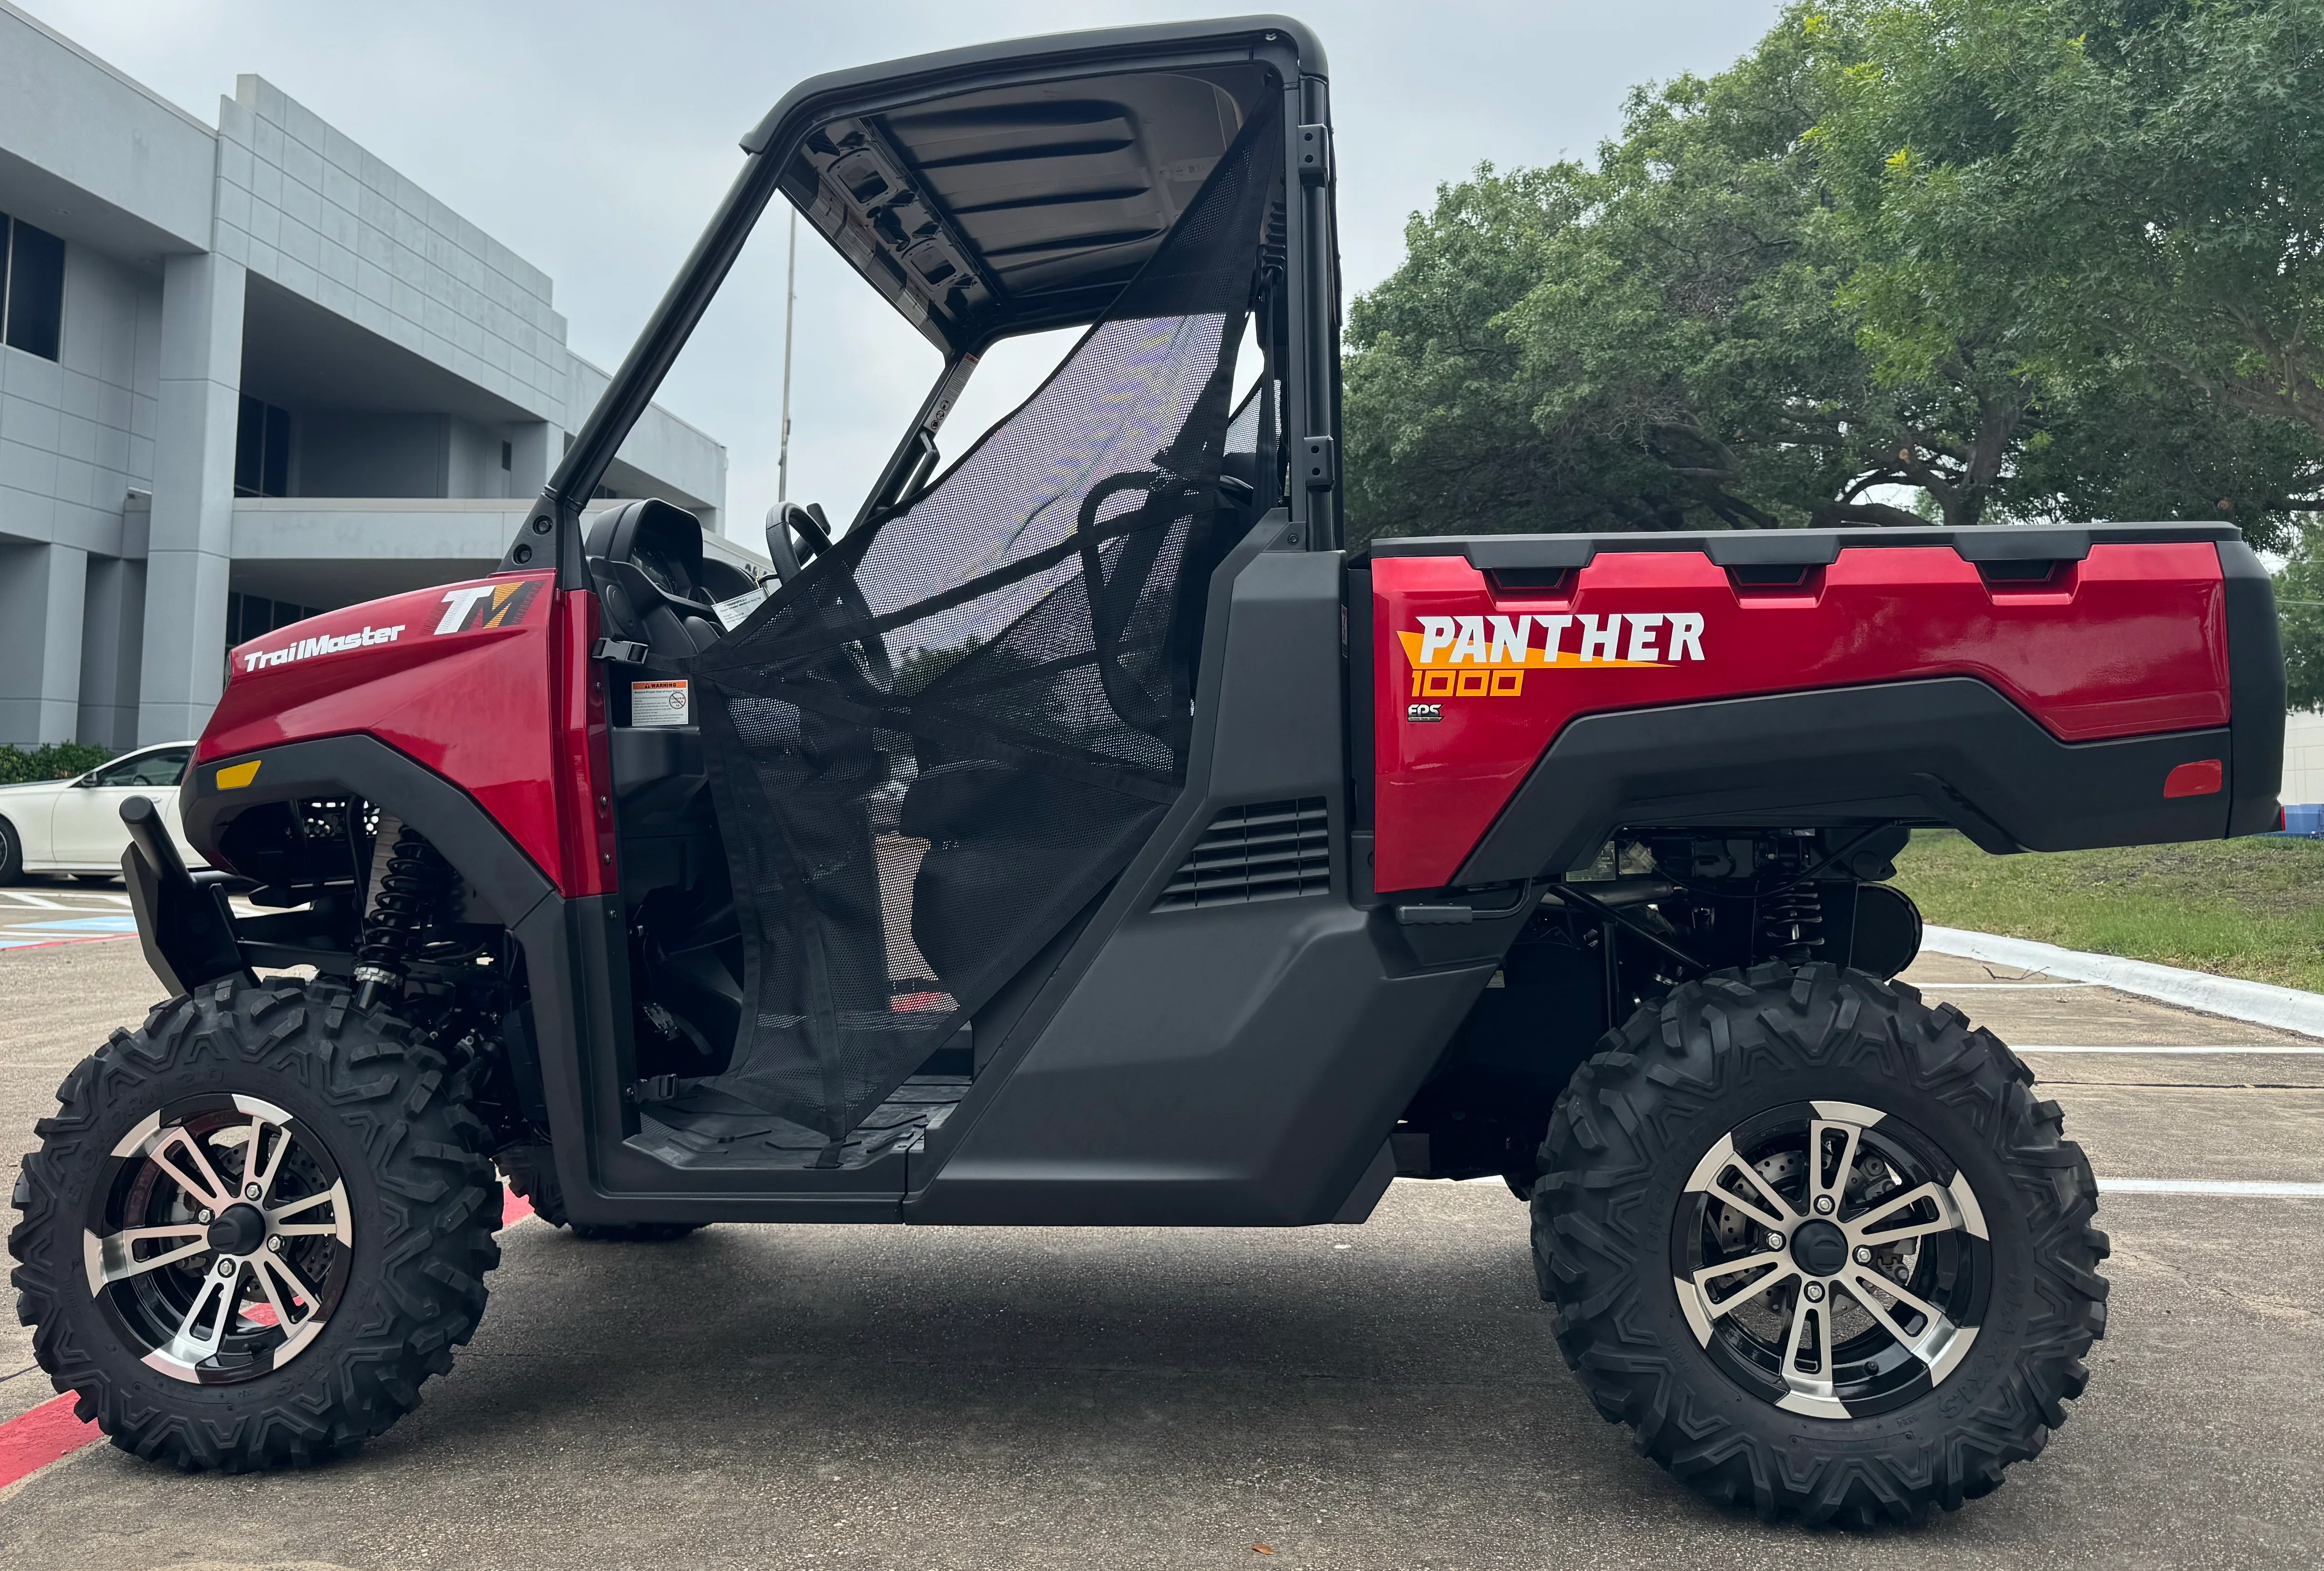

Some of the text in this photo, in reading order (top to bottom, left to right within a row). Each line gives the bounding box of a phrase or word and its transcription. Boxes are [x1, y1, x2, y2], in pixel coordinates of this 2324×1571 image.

[433, 581, 538, 635] TM
[244, 624, 406, 672] TrailMaster
[1415, 612, 1705, 663] PANTHER
[1411, 669, 1525, 697] 1000
[1408, 704, 1442, 717] EPS
[1935, 1273, 2029, 1423] MAXXIS
